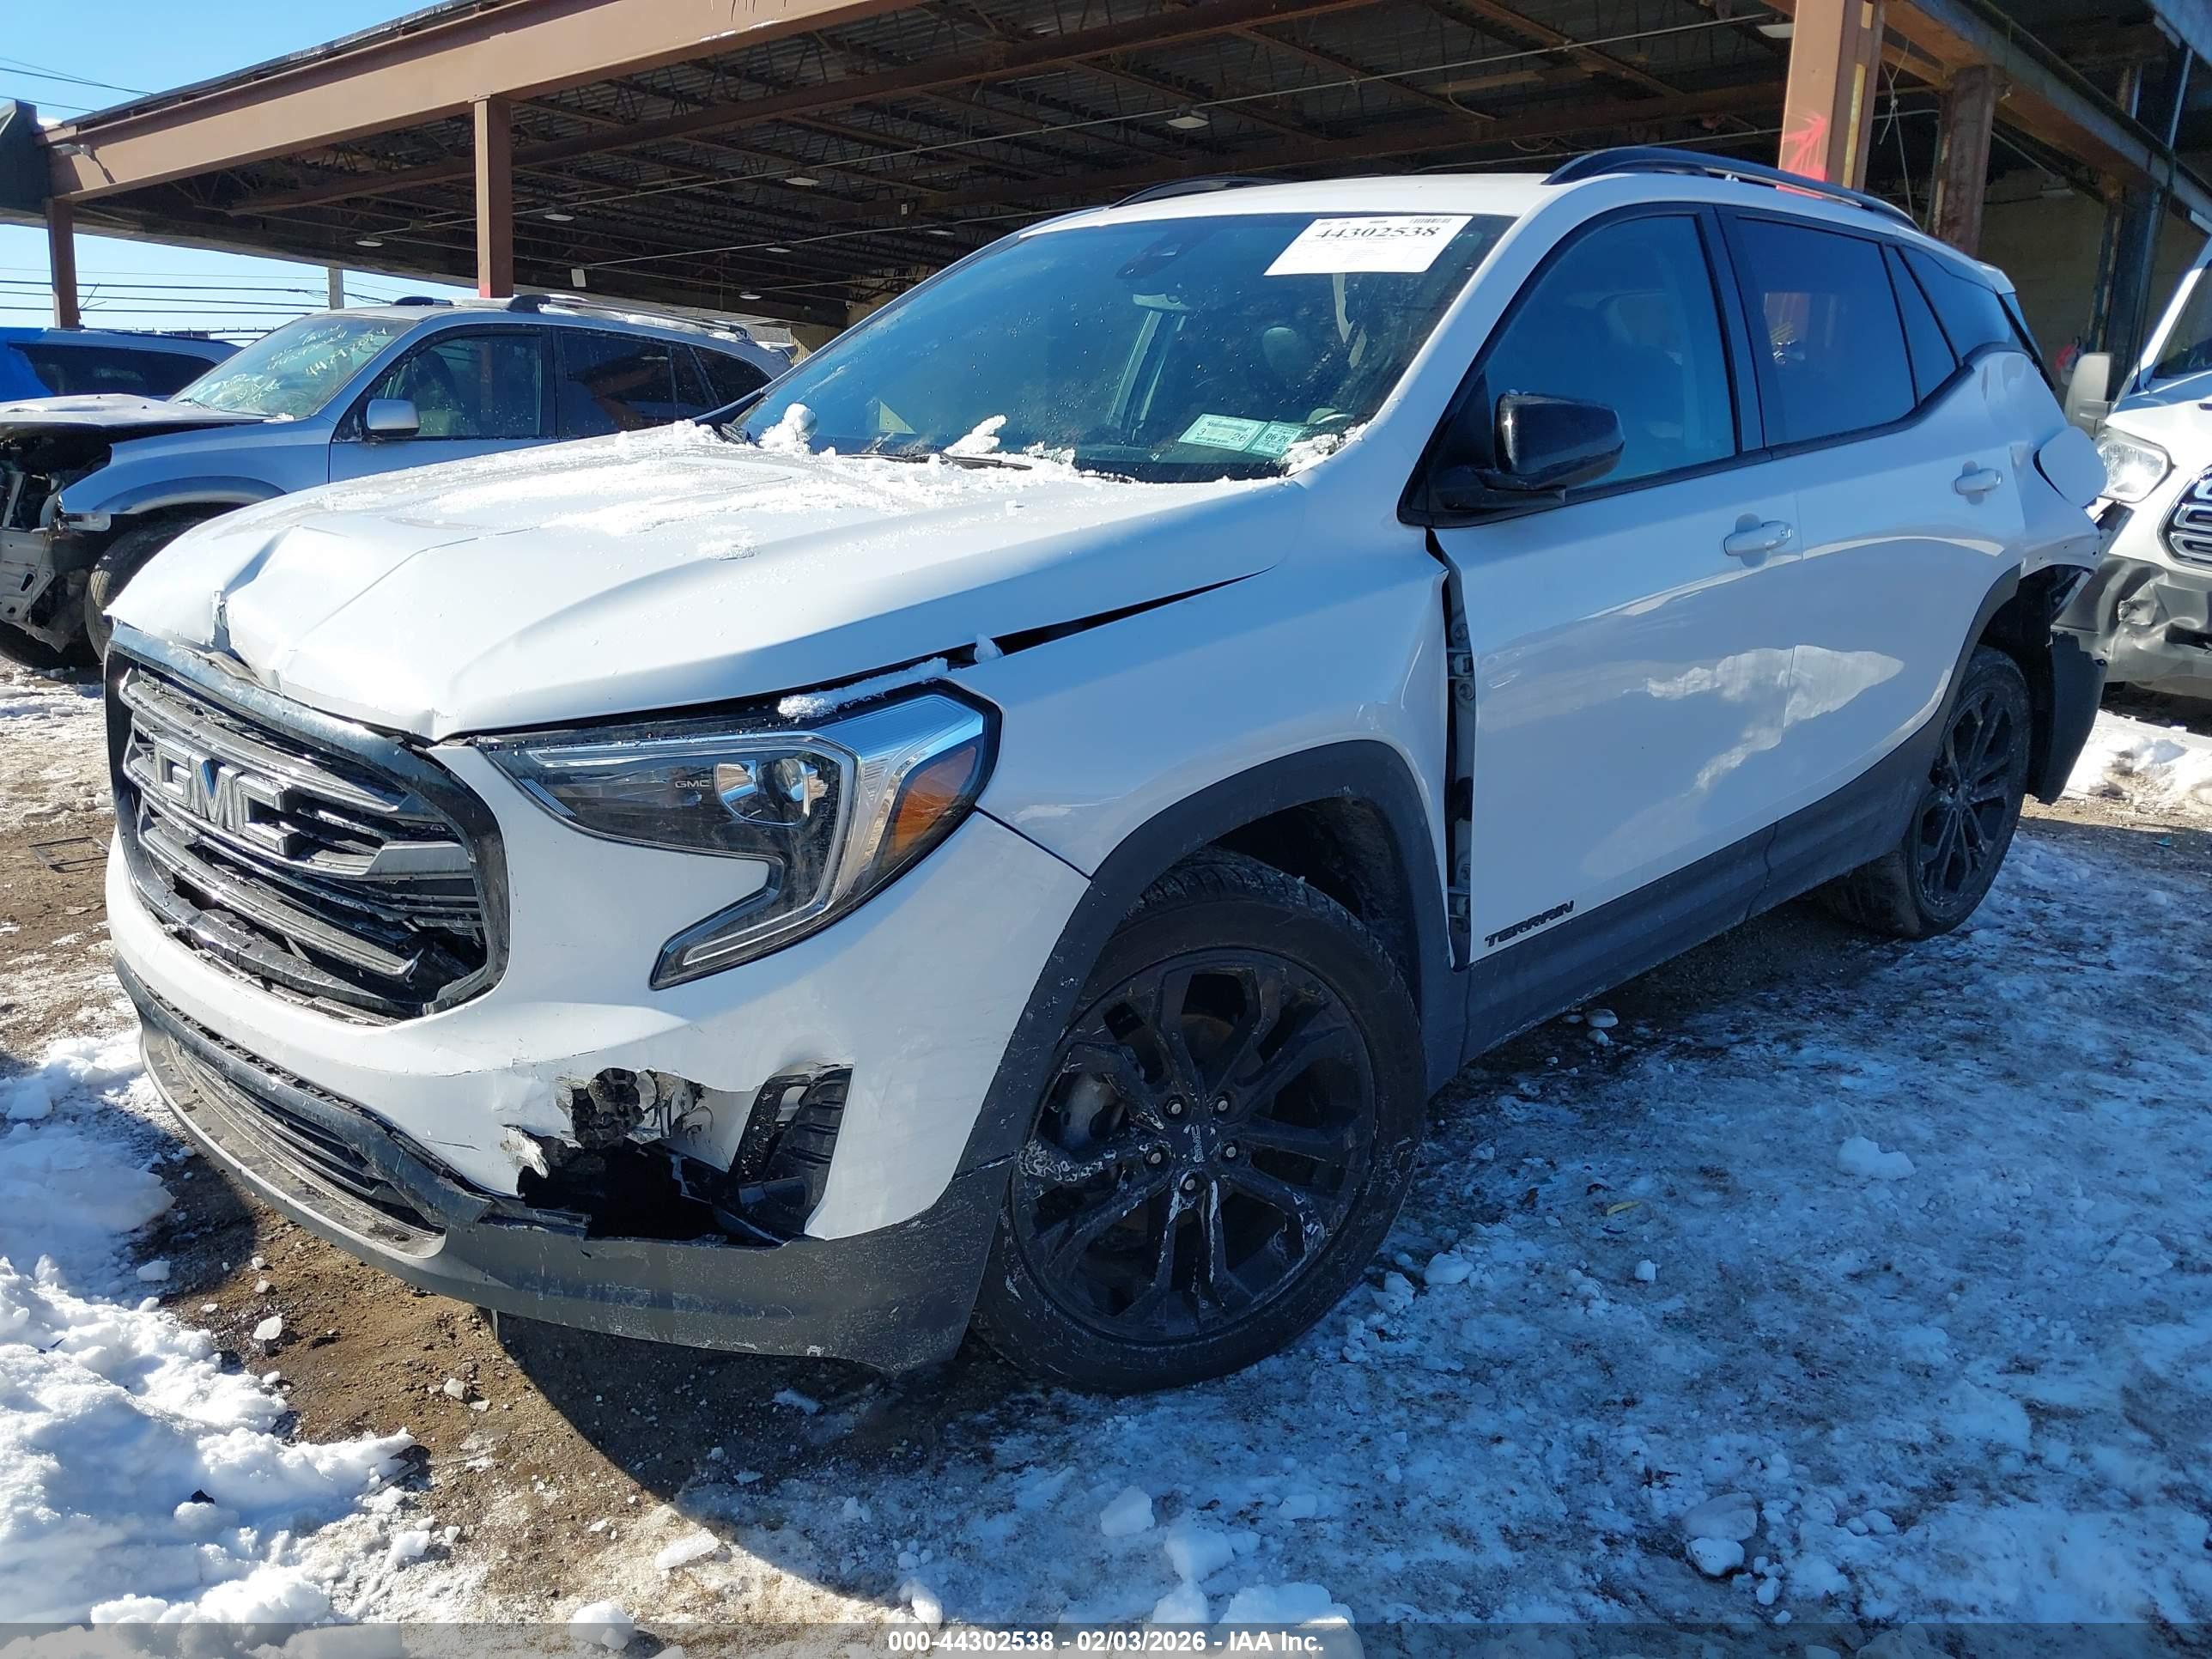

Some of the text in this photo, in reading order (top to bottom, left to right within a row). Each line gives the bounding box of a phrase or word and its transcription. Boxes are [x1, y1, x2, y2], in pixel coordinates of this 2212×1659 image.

[1315, 227, 1441, 239] 44302538
[1230, 433, 1249, 442] 26
[675, 779, 712, 789] GMC
[155, 738, 298, 860] GMC
[1484, 899, 1575, 948] TERRAIN
